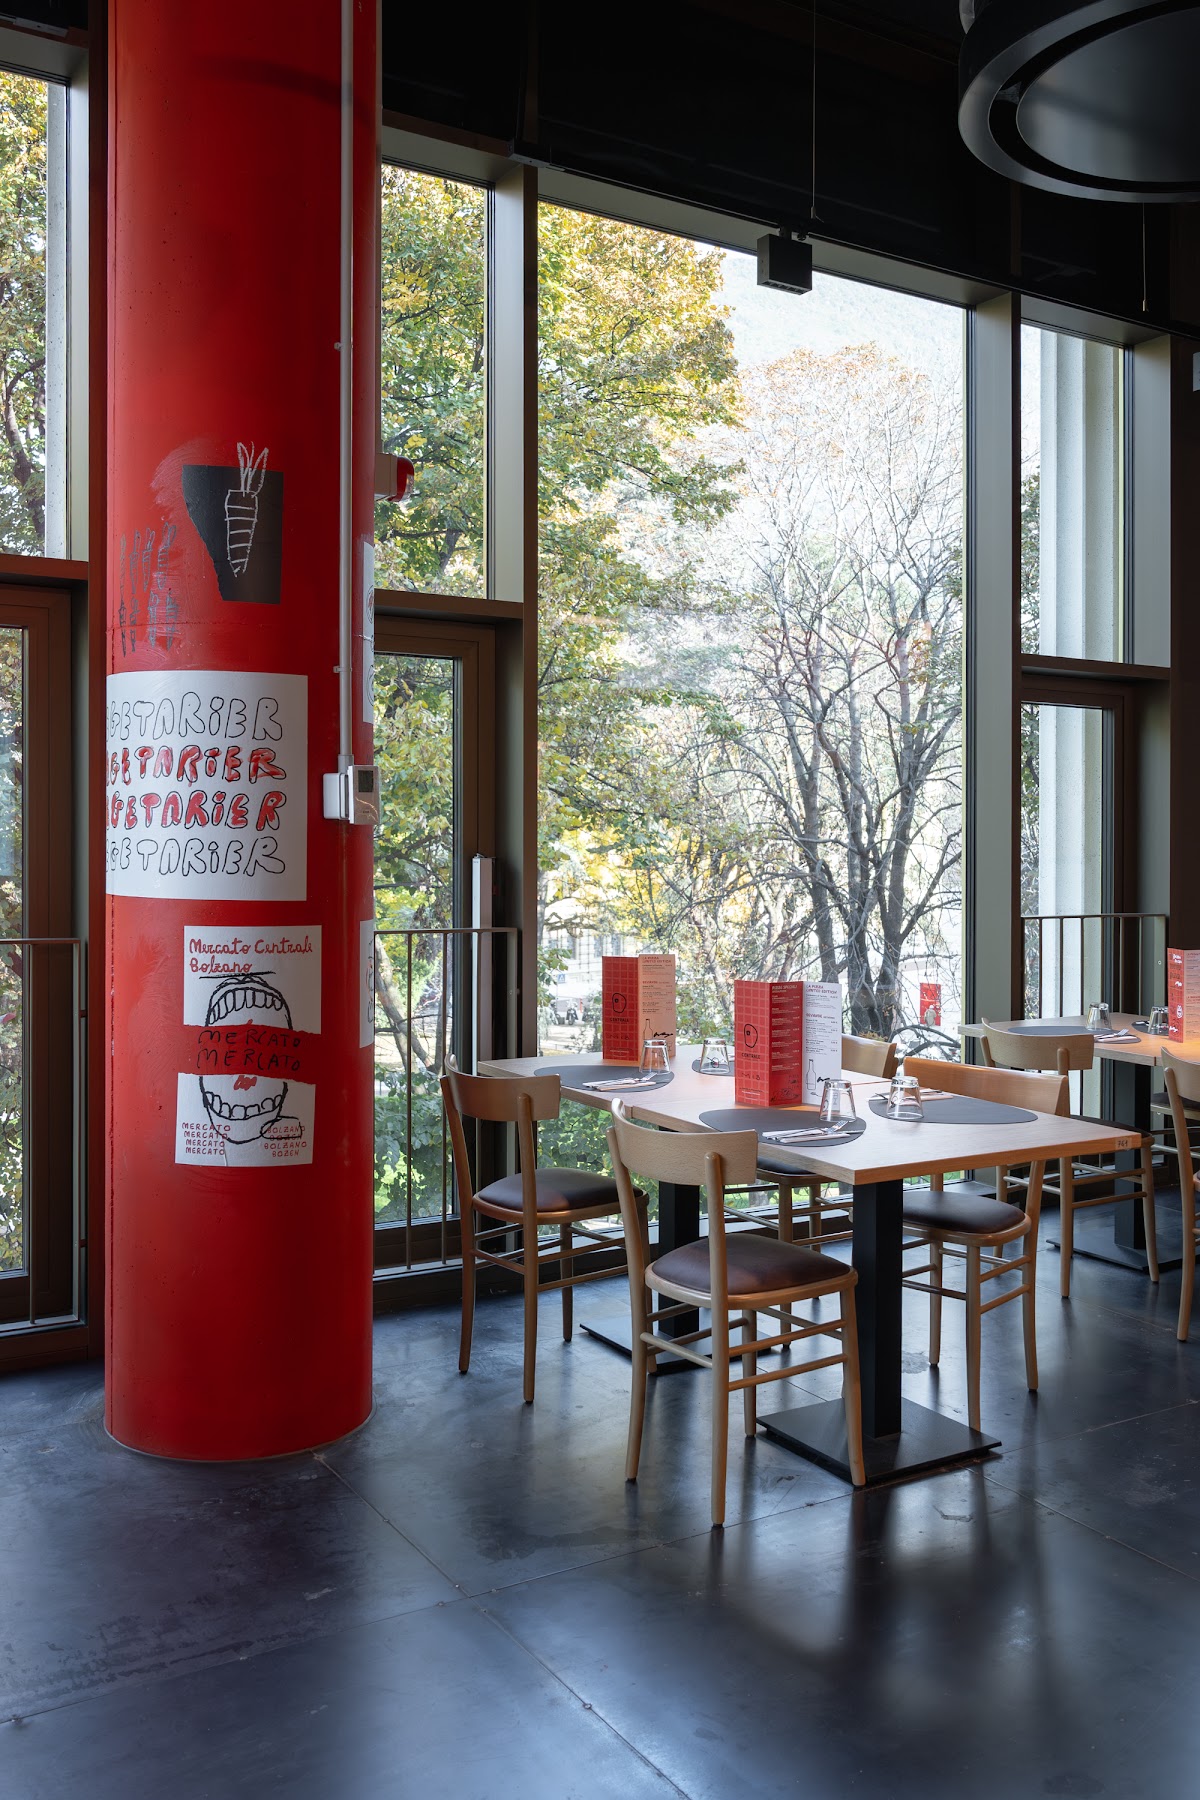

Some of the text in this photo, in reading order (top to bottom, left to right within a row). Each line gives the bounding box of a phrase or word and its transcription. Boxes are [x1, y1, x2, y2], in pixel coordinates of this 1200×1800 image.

[189, 935, 313, 955] Mercato Centrale
[189, 955, 253, 975] Bolzano
[198, 1029, 301, 1048] MERCATO
[197, 1048, 300, 1071] MERCATO
[181, 1122, 231, 1132] MERCATO
[267, 1125, 305, 1133] BOLZANO
[184, 1131, 228, 1139] MERCATO
[185, 1139, 225, 1147] MERCATO
[264, 1141, 307, 1150] BOLZANO
[185, 1147, 225, 1156] MERCATO
[272, 1149, 299, 1158] BOZEN
